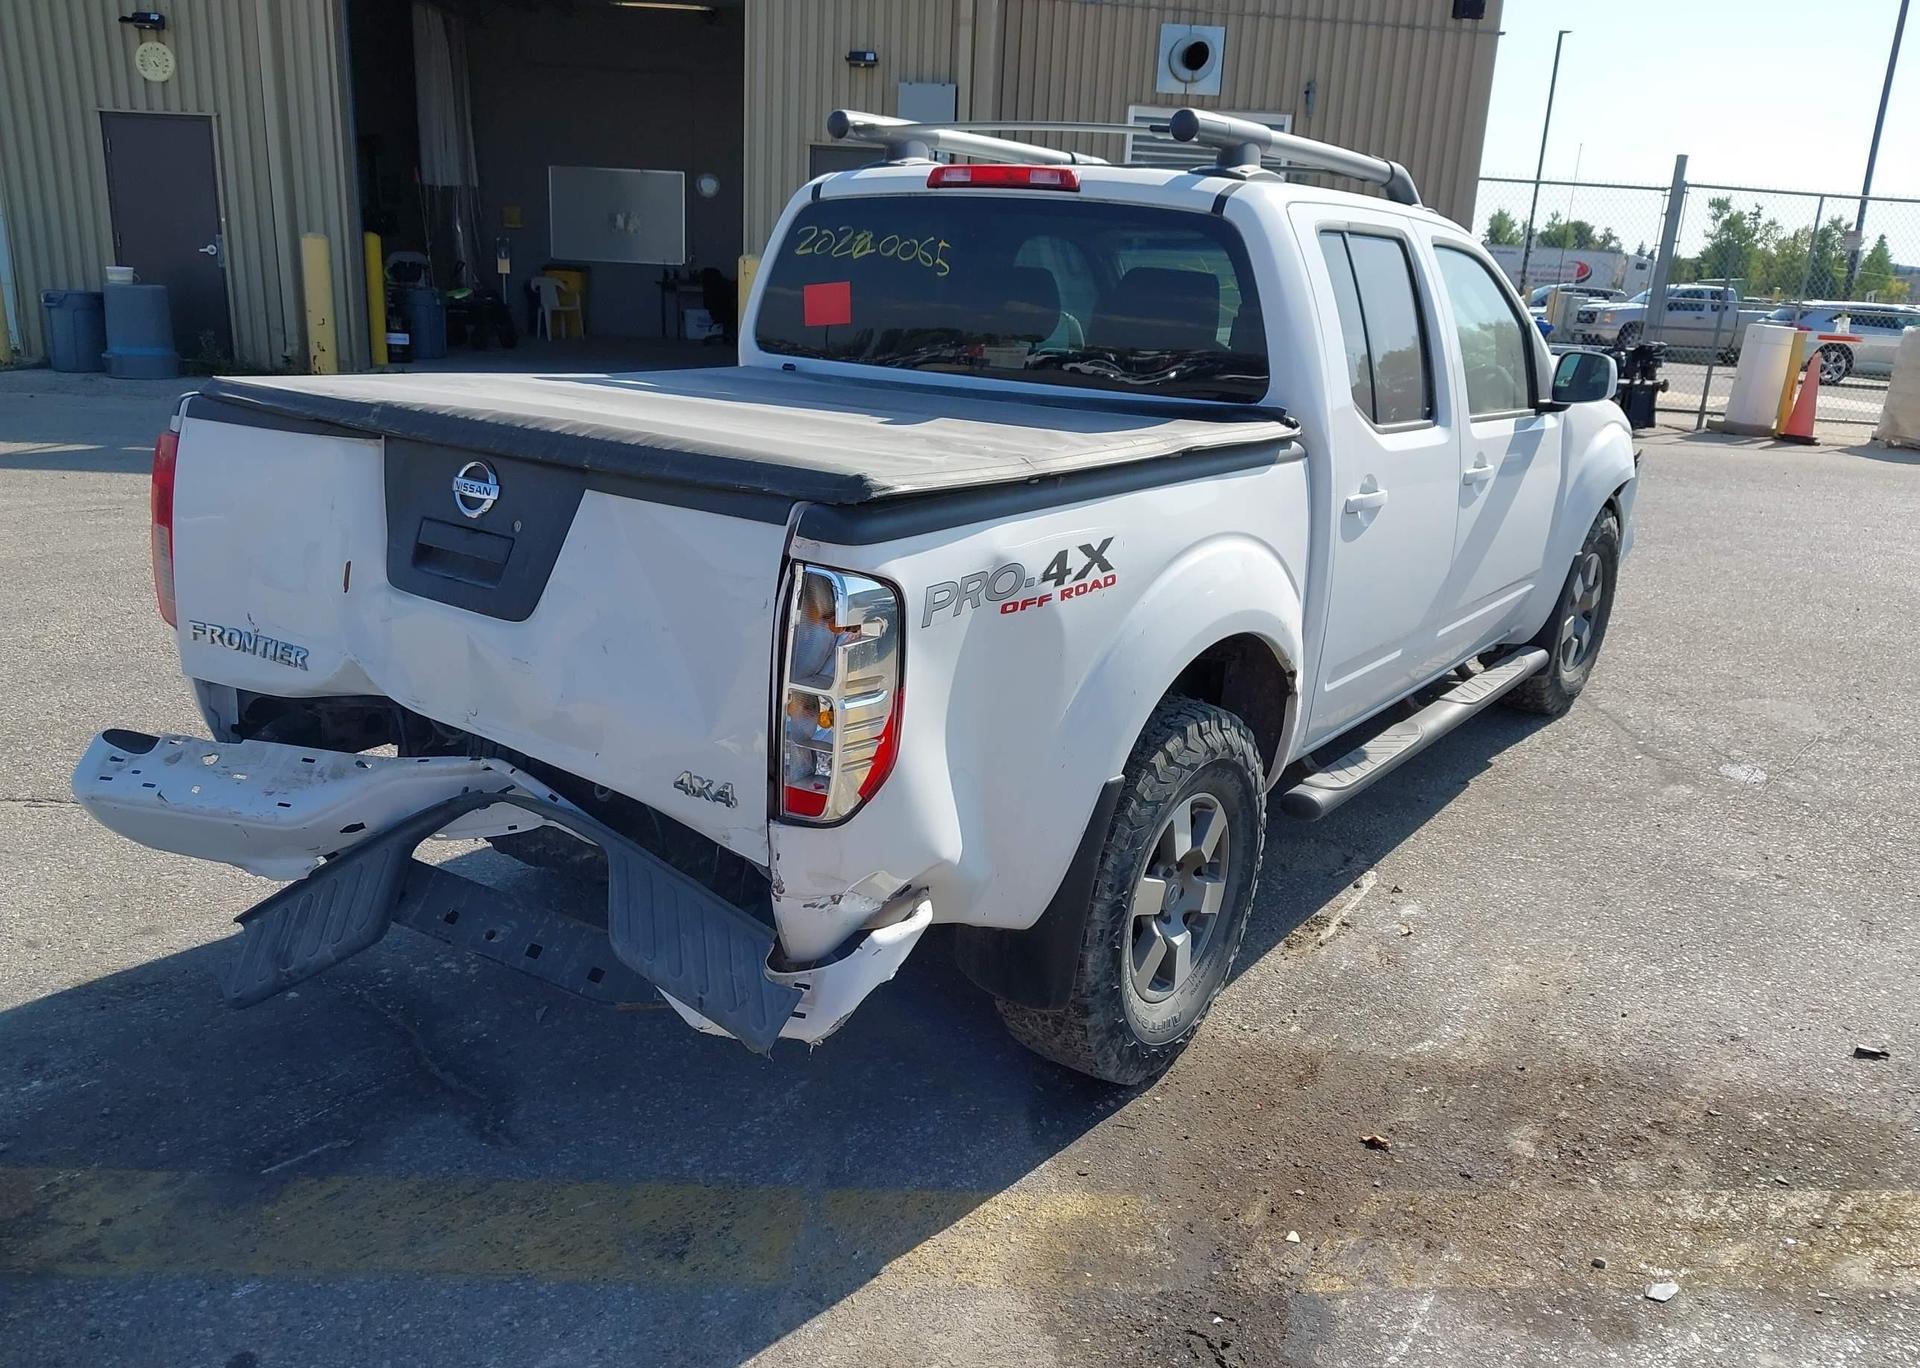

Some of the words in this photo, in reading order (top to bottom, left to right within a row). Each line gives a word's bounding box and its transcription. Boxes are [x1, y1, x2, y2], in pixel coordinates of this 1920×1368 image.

[455, 481, 492, 496] NISSAN
[1000, 592, 1053, 615] OFF
[1060, 574, 1118, 602] ROAD
[188, 619, 310, 672] FRONTIER
